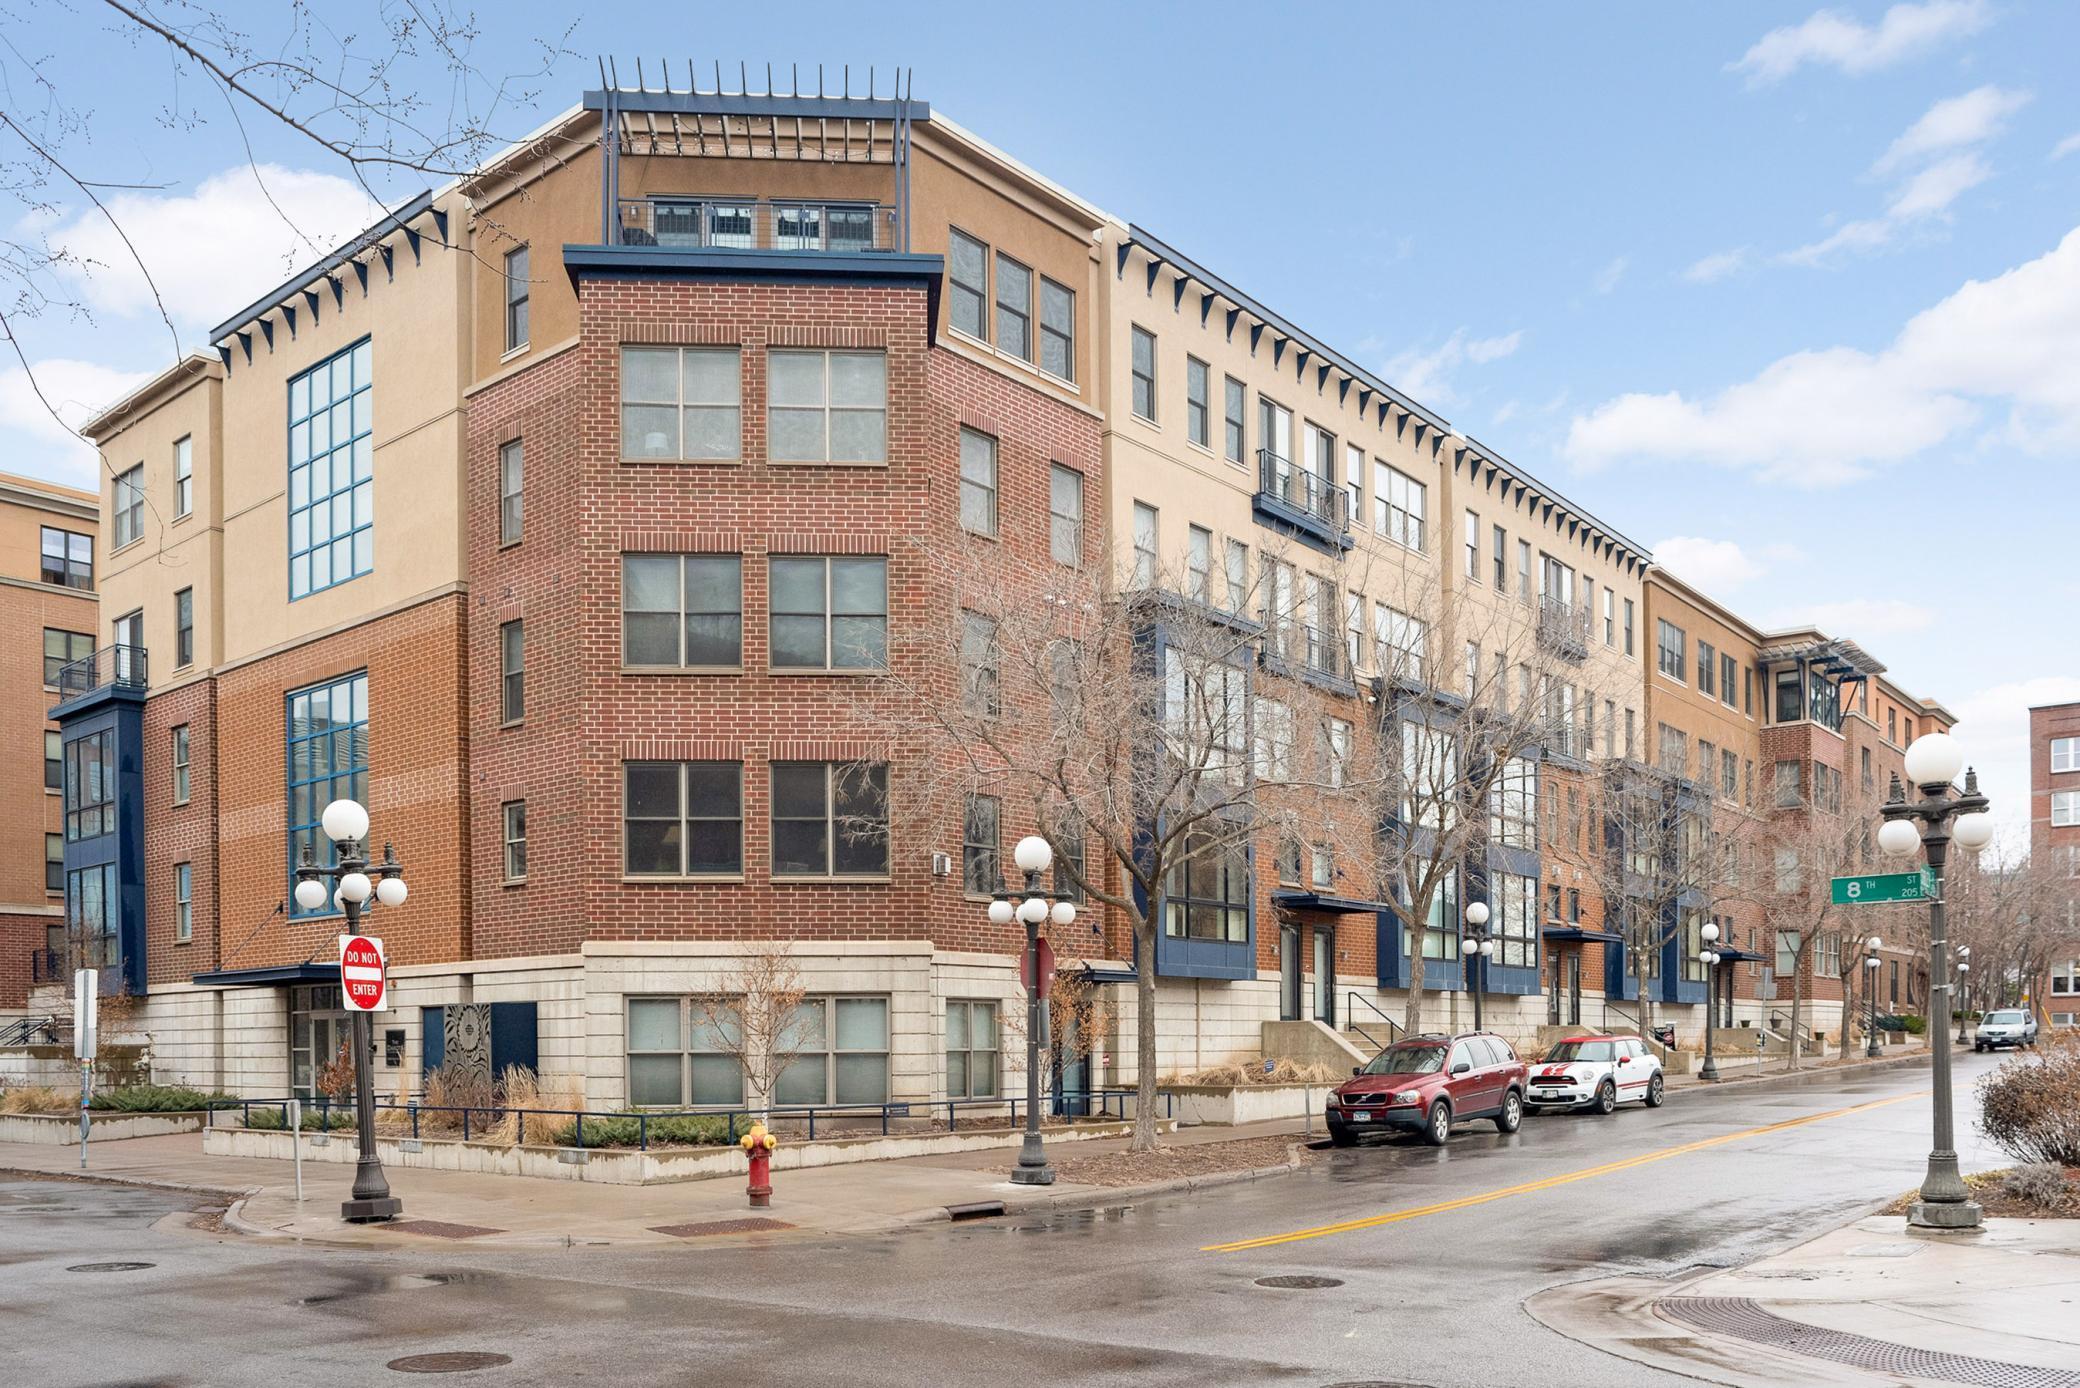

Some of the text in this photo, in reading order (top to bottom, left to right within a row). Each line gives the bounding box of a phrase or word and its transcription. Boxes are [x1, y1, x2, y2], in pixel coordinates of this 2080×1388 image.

[1907, 876, 1916, 884] ST
[1902, 888, 1918, 897] 205
[347, 951, 377, 964] DO NOT
[352, 983, 378, 996] ENTER
